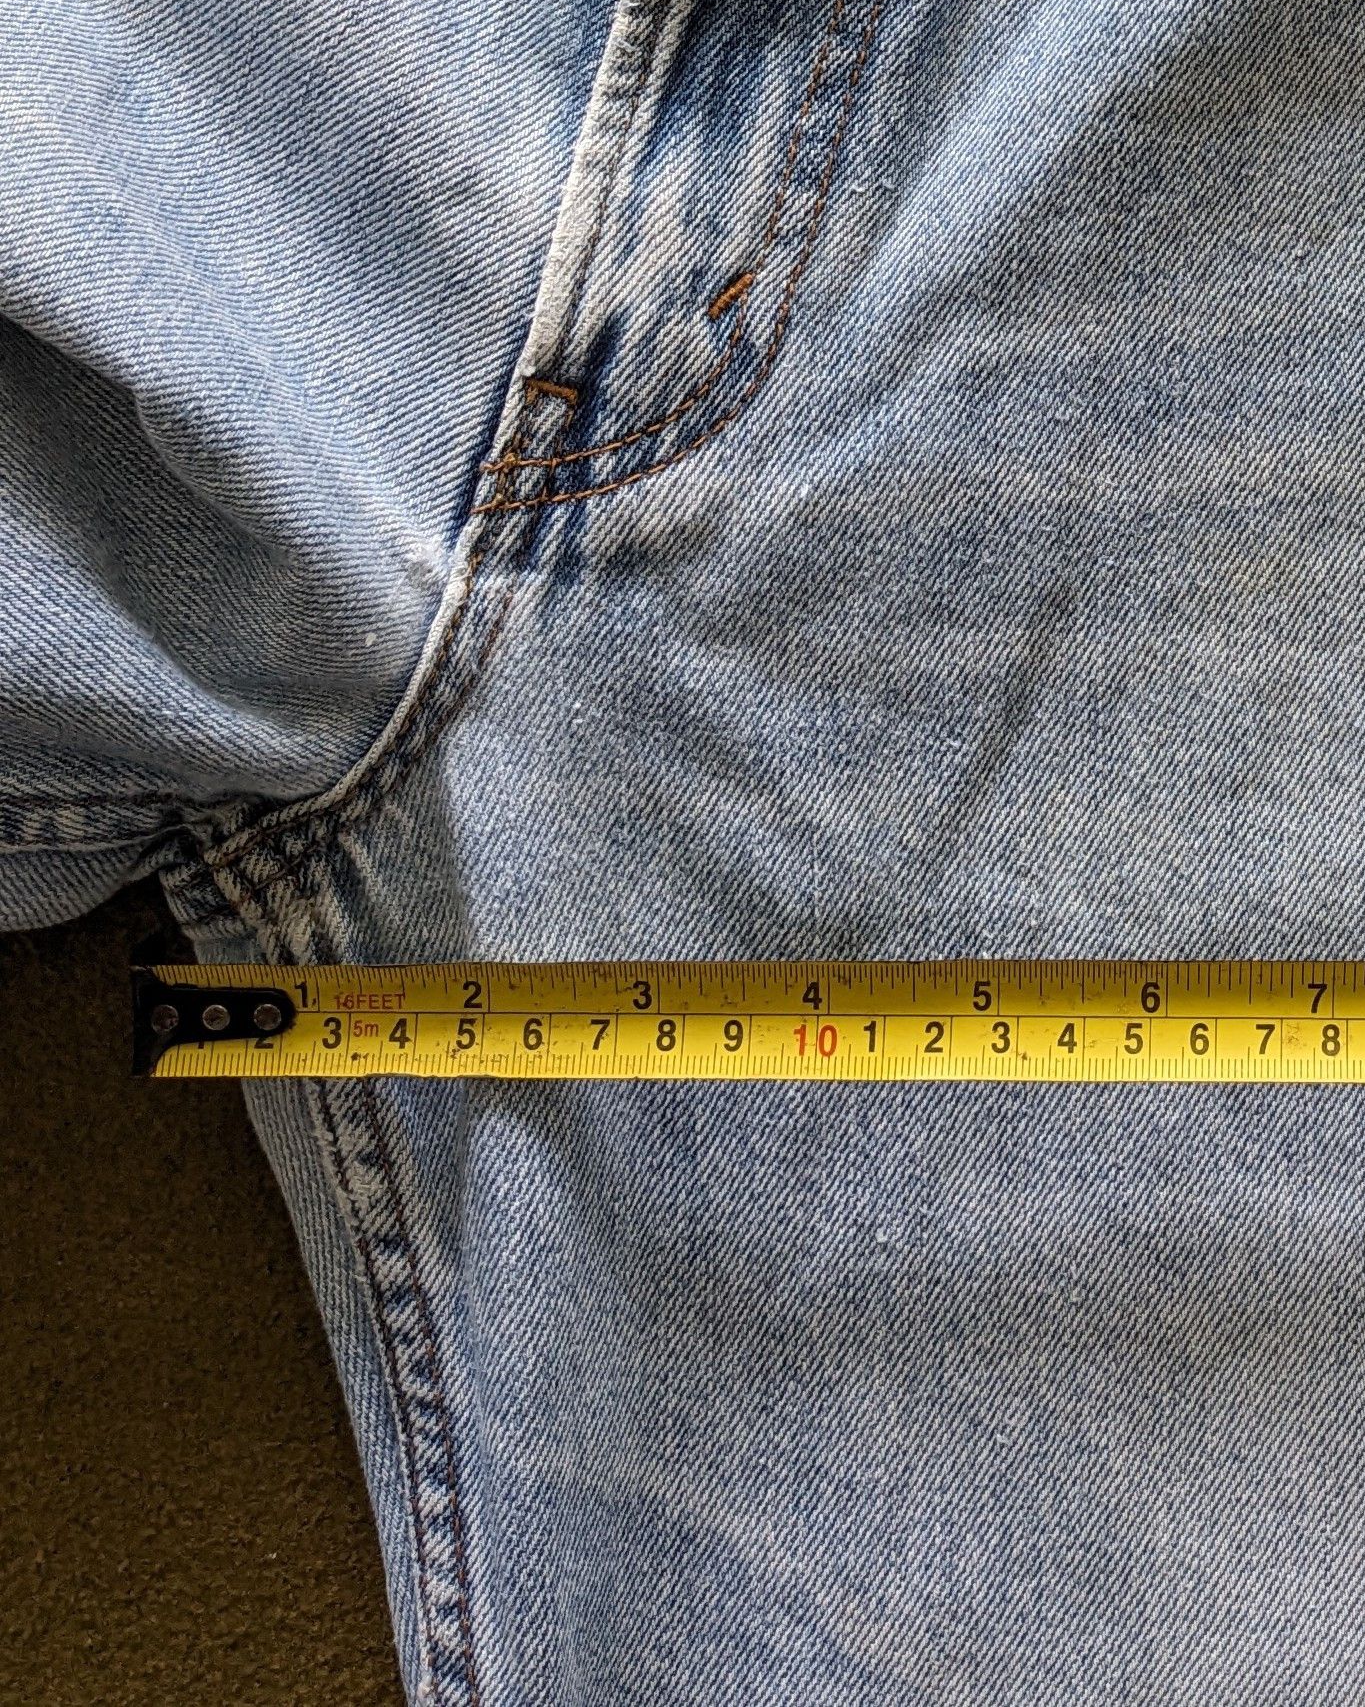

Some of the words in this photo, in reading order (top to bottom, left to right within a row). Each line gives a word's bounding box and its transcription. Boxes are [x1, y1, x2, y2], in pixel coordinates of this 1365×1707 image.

[462, 981, 482, 1009] 2
[632, 981, 653, 1010] 3
[802, 981, 823, 1010] 4
[973, 982, 992, 1011] 5
[1140, 983, 1160, 1012] 6
[1308, 984, 1327, 1013] 7
[322, 1018, 342, 1047] 3
[353, 1021, 379, 1037] 5m
[389, 1019, 409, 1048] 4
[456, 1019, 476, 1048] 5
[523, 1019, 542, 1049] 6
[590, 1020, 610, 1049] 7
[656, 1020, 676, 1050] 8
[724, 1021, 744, 1050] 9
[794, 1025, 838, 1056] 10
[863, 1022, 877, 1052] 1
[924, 1023, 944, 1052] 2
[991, 1023, 1010, 1052] 3
[1057, 1024, 1077, 1053] 4
[1124, 1024, 1144, 1053] 5
[1190, 1024, 1209, 1054] 6
[1255, 1025, 1275, 1055] 7
[1321, 1026, 1340, 1056] 8
